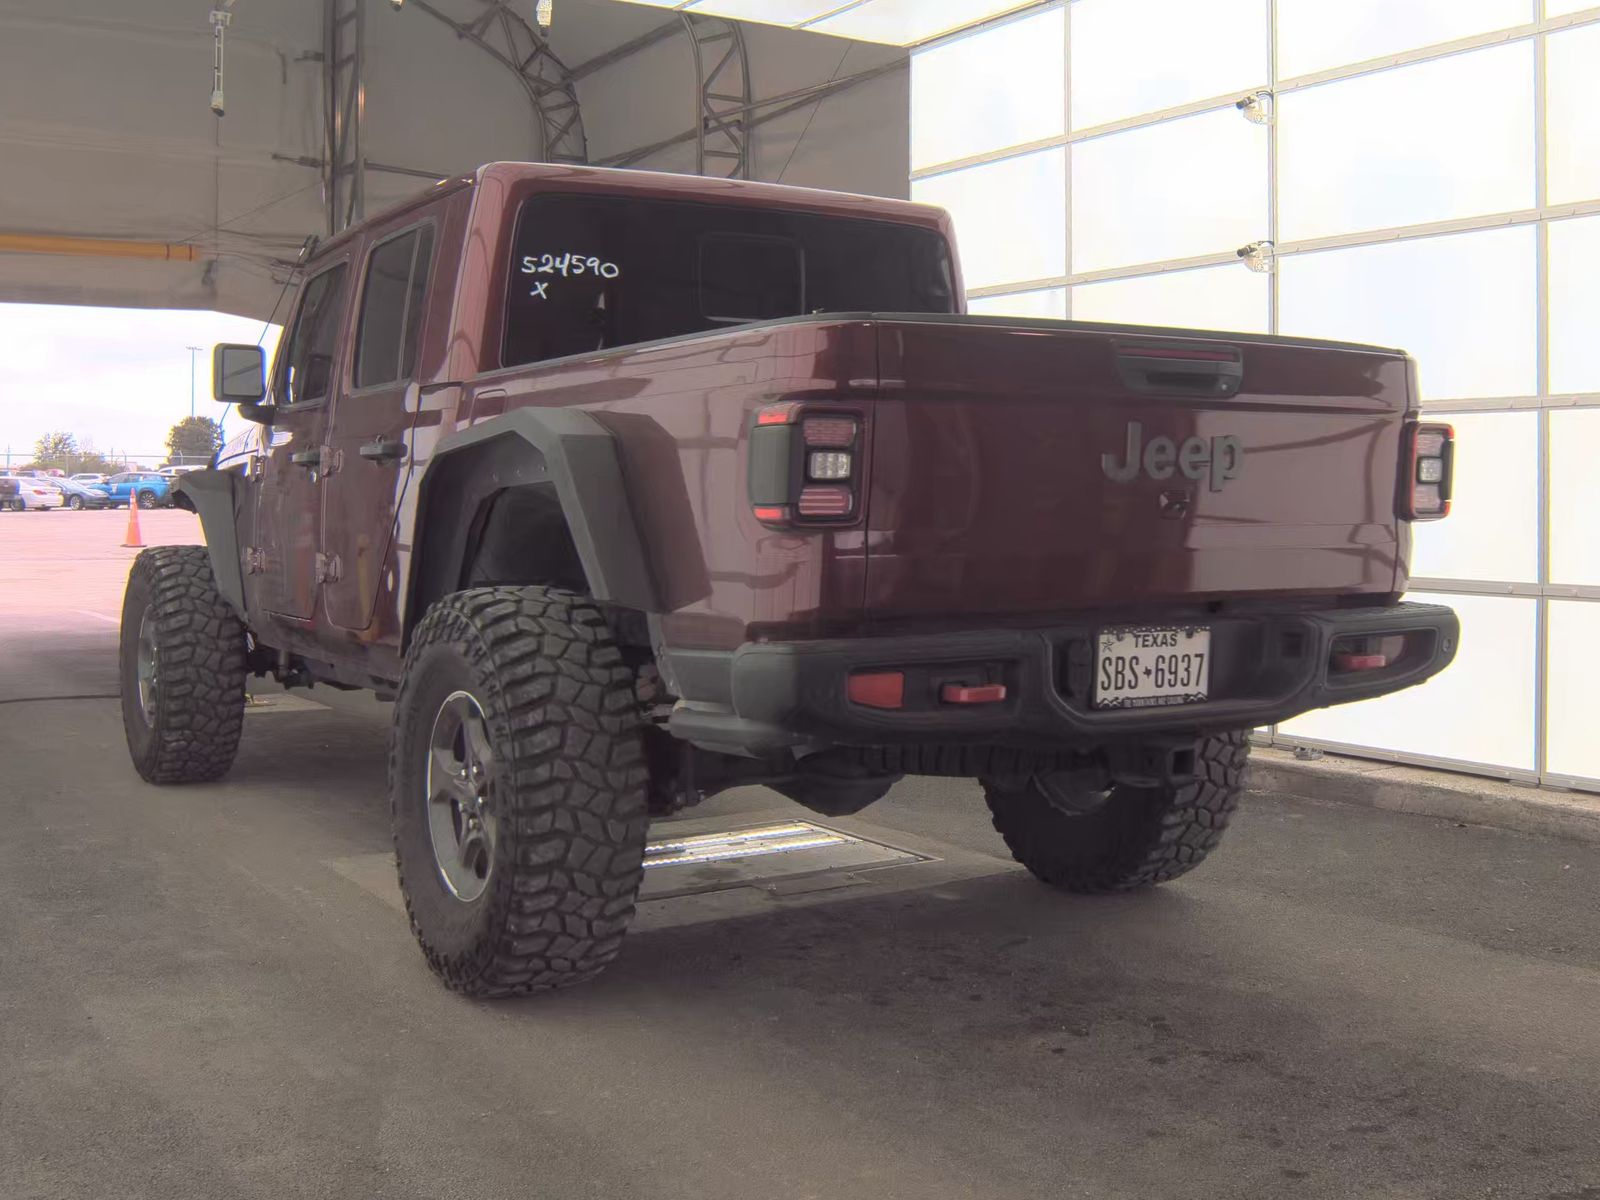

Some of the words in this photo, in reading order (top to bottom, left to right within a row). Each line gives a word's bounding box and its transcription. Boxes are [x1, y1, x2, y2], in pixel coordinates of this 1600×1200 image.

[521, 253, 619, 278] 524590
[1101, 421, 1244, 493] Jeep
[1133, 633, 1178, 648] TEXAS
